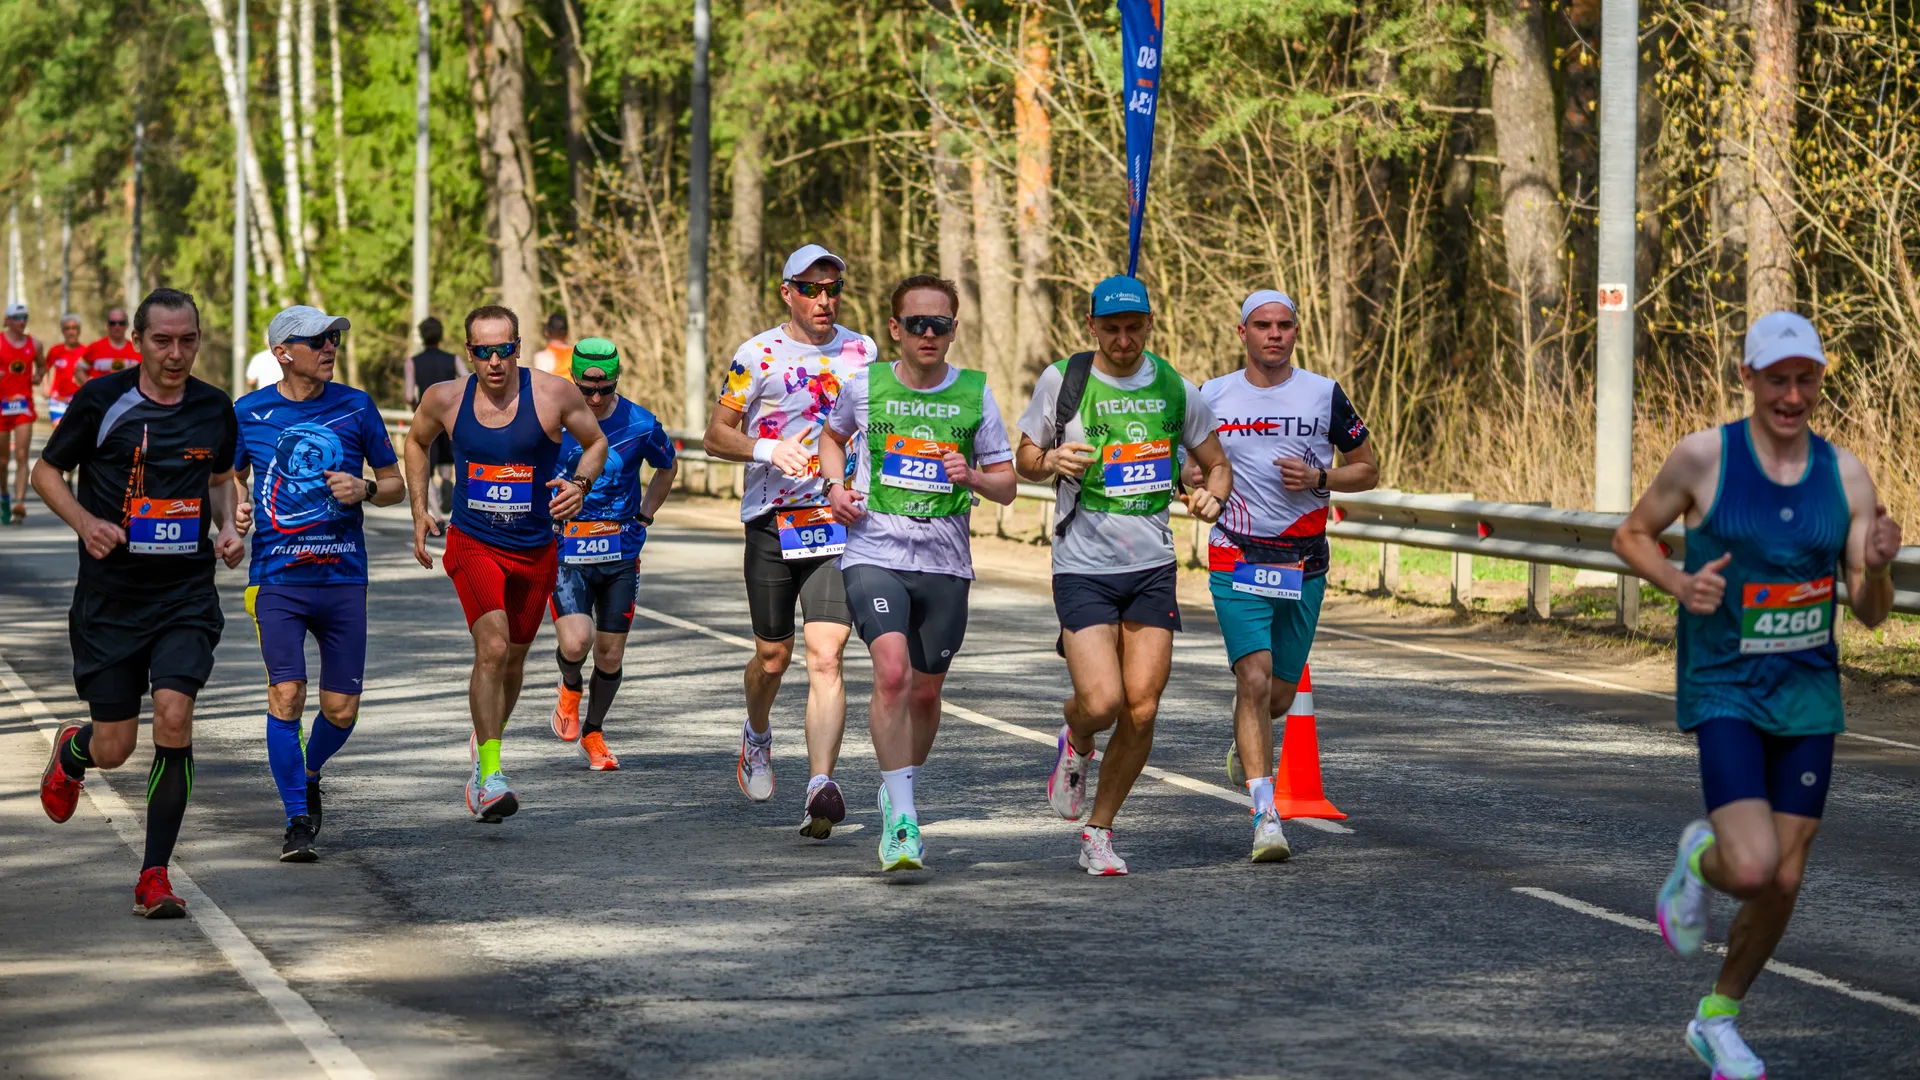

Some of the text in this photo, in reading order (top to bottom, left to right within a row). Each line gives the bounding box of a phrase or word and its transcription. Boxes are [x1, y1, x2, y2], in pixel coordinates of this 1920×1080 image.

[886, 400, 960, 418] ПЕЙСЕР
[1096, 397, 1167, 416] ПЕЙСЕР
[900, 459, 937, 479] 228
[1122, 464, 1156, 483] 223
[487, 485, 512, 501] 49
[154, 522, 181, 540] 50
[800, 528, 827, 545] 96
[270, 542, 357, 555] ГАГАРИНСКИЙ
[576, 539, 609, 554] 240
[1254, 568, 1281, 586] 80
[1753, 608, 1822, 635] 4260
